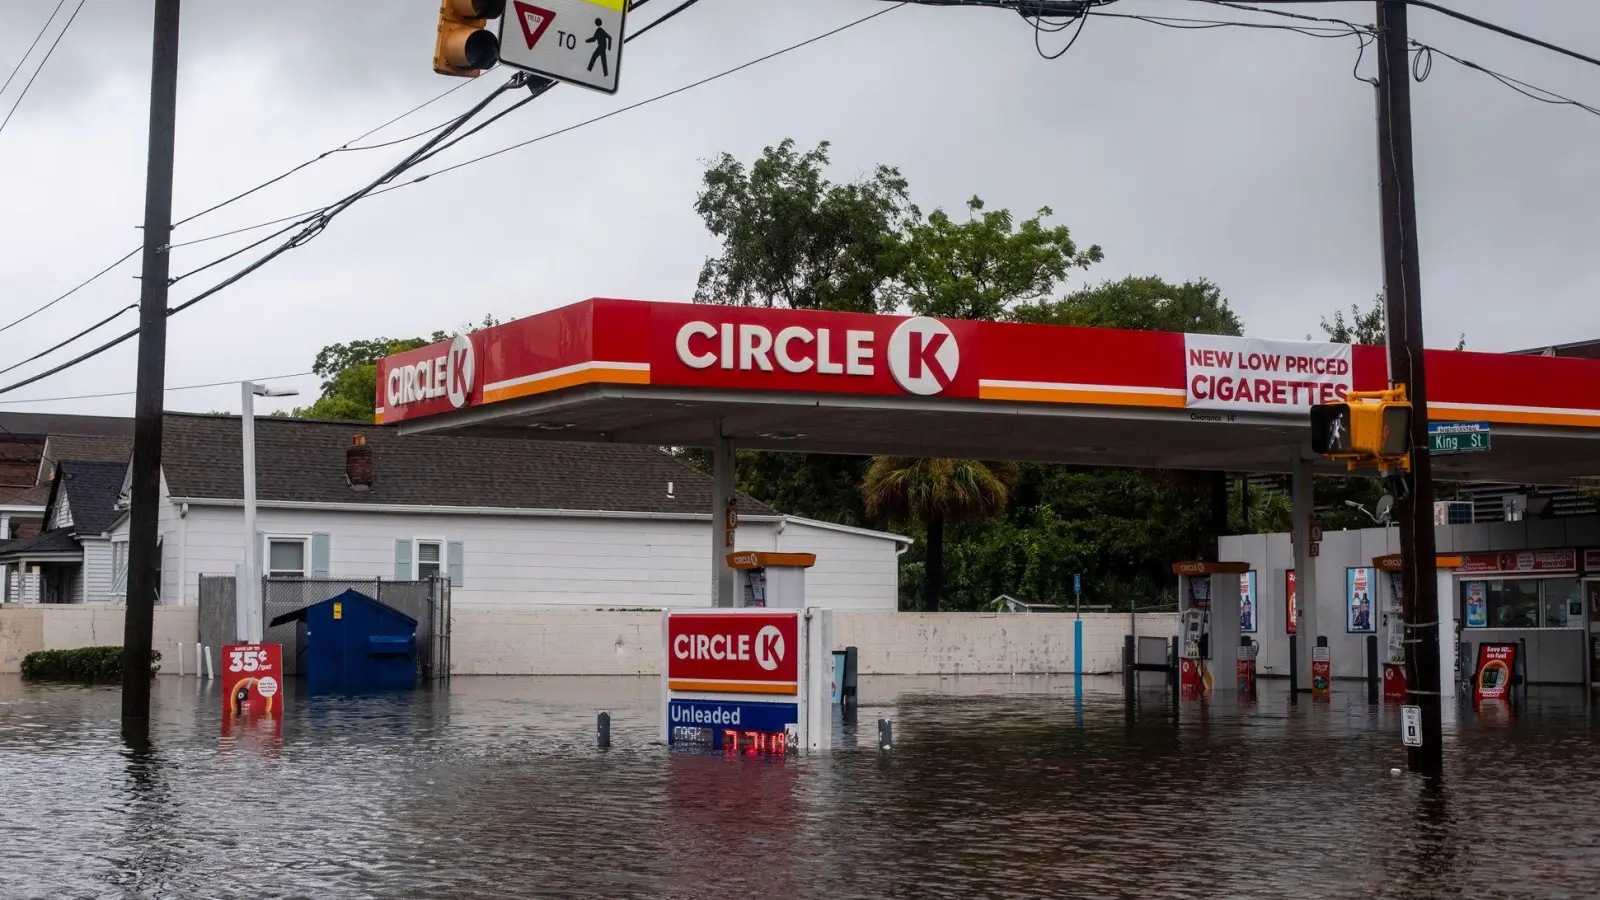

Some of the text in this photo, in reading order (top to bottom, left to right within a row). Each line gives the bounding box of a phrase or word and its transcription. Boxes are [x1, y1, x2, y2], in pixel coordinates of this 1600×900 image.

[527, 14, 576, 50] YIELD TO
[676, 320, 956, 394] CIRCLE K
[1189, 349, 1349, 376] NEW LOW PRICED
[388, 356, 448, 407] CIRCLE
[1191, 374, 1349, 406] CIGARETTES
[1190, 412, 1222, 421] Clearance
[1435, 433, 1482, 449] King St
[733, 556, 751, 565] CIRCLE
[1383, 614, 1388, 627] 2
[229, 650, 267, 672] 35¢
[673, 631, 784, 669] CIRCLE K
[671, 705, 741, 725] Unleaded
